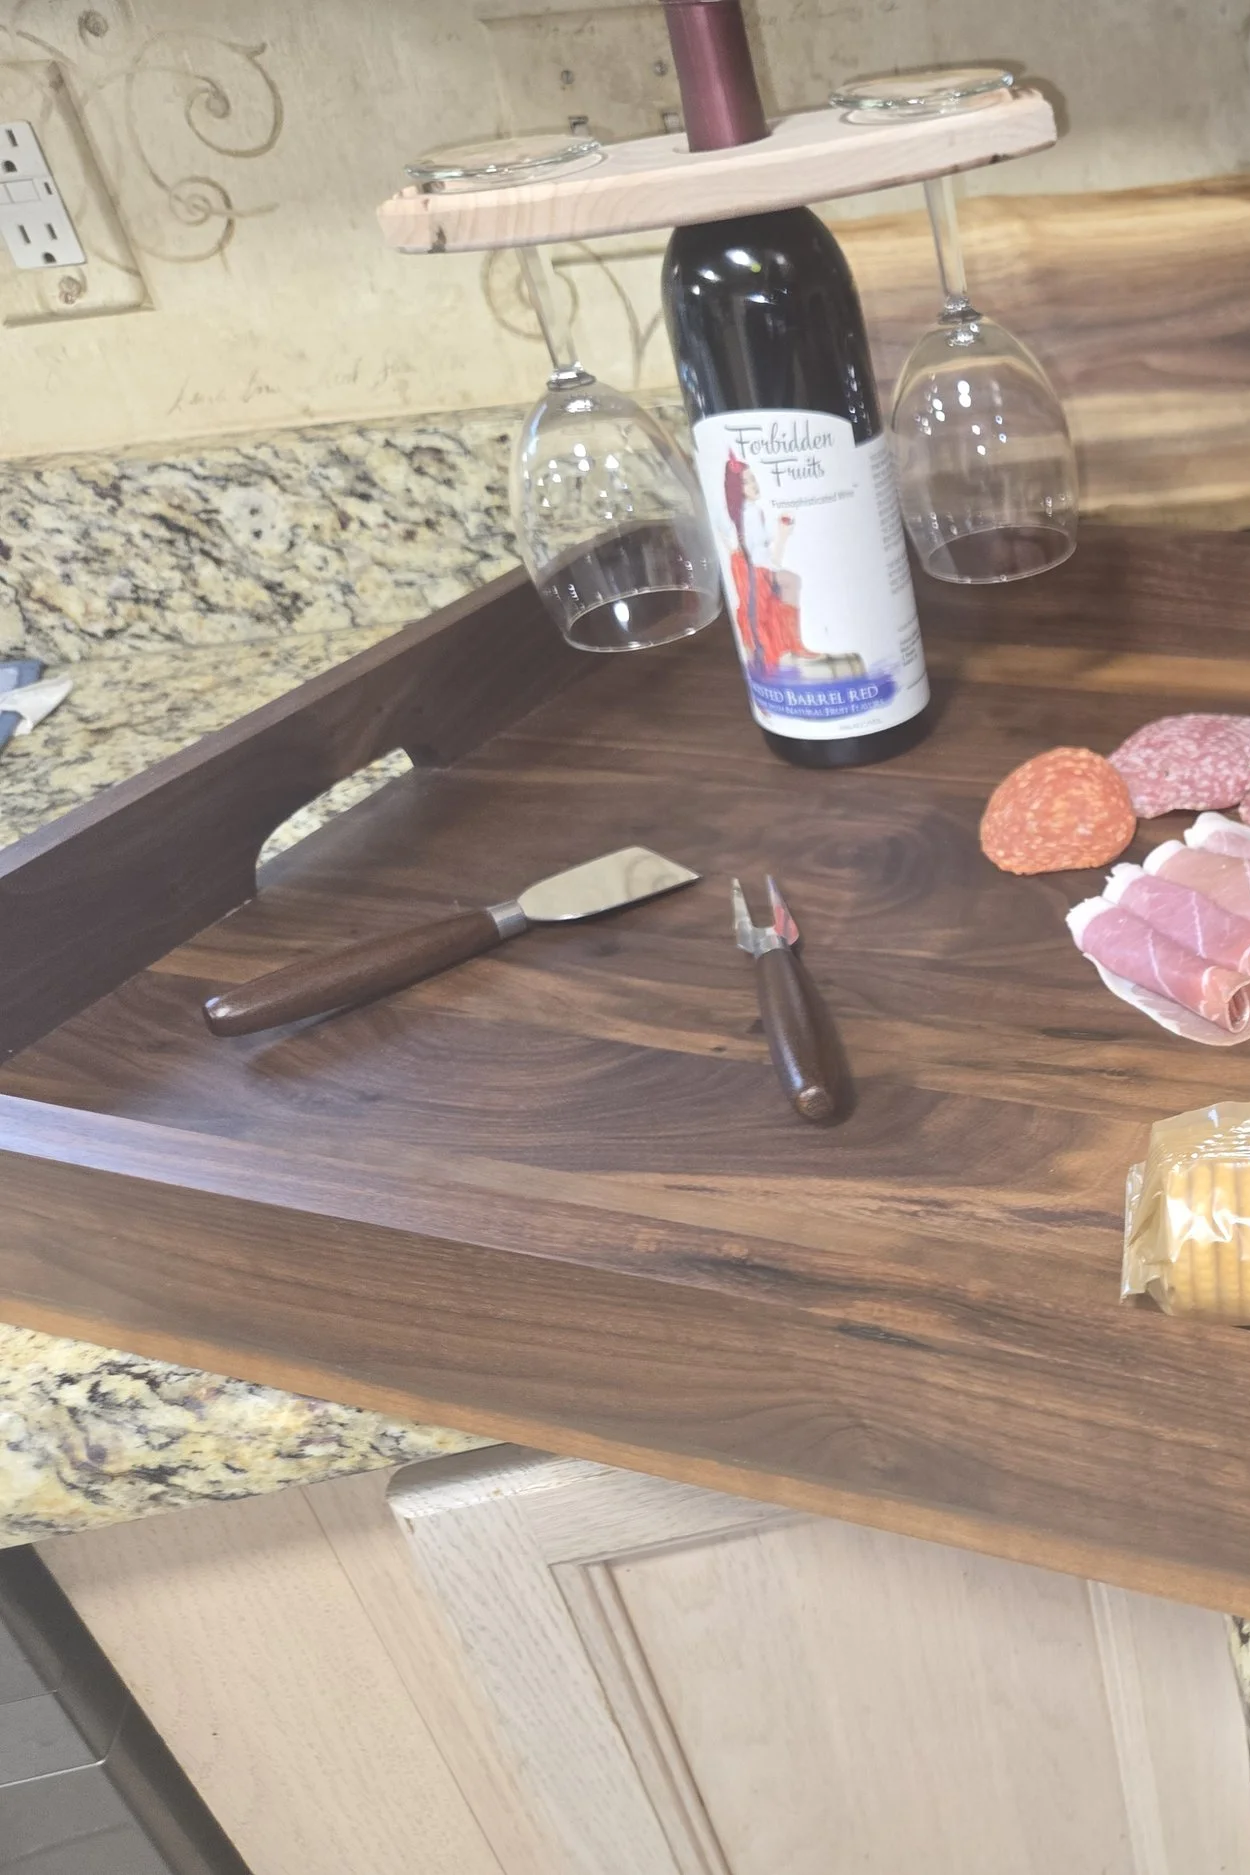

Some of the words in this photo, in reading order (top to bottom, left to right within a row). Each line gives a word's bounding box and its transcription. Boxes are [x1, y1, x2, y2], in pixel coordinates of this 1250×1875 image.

[724, 419, 833, 459] Forbidden
[760, 456, 825, 487] Fruits
[786, 689, 845, 706] BARREL
[848, 684, 879, 701] RED
